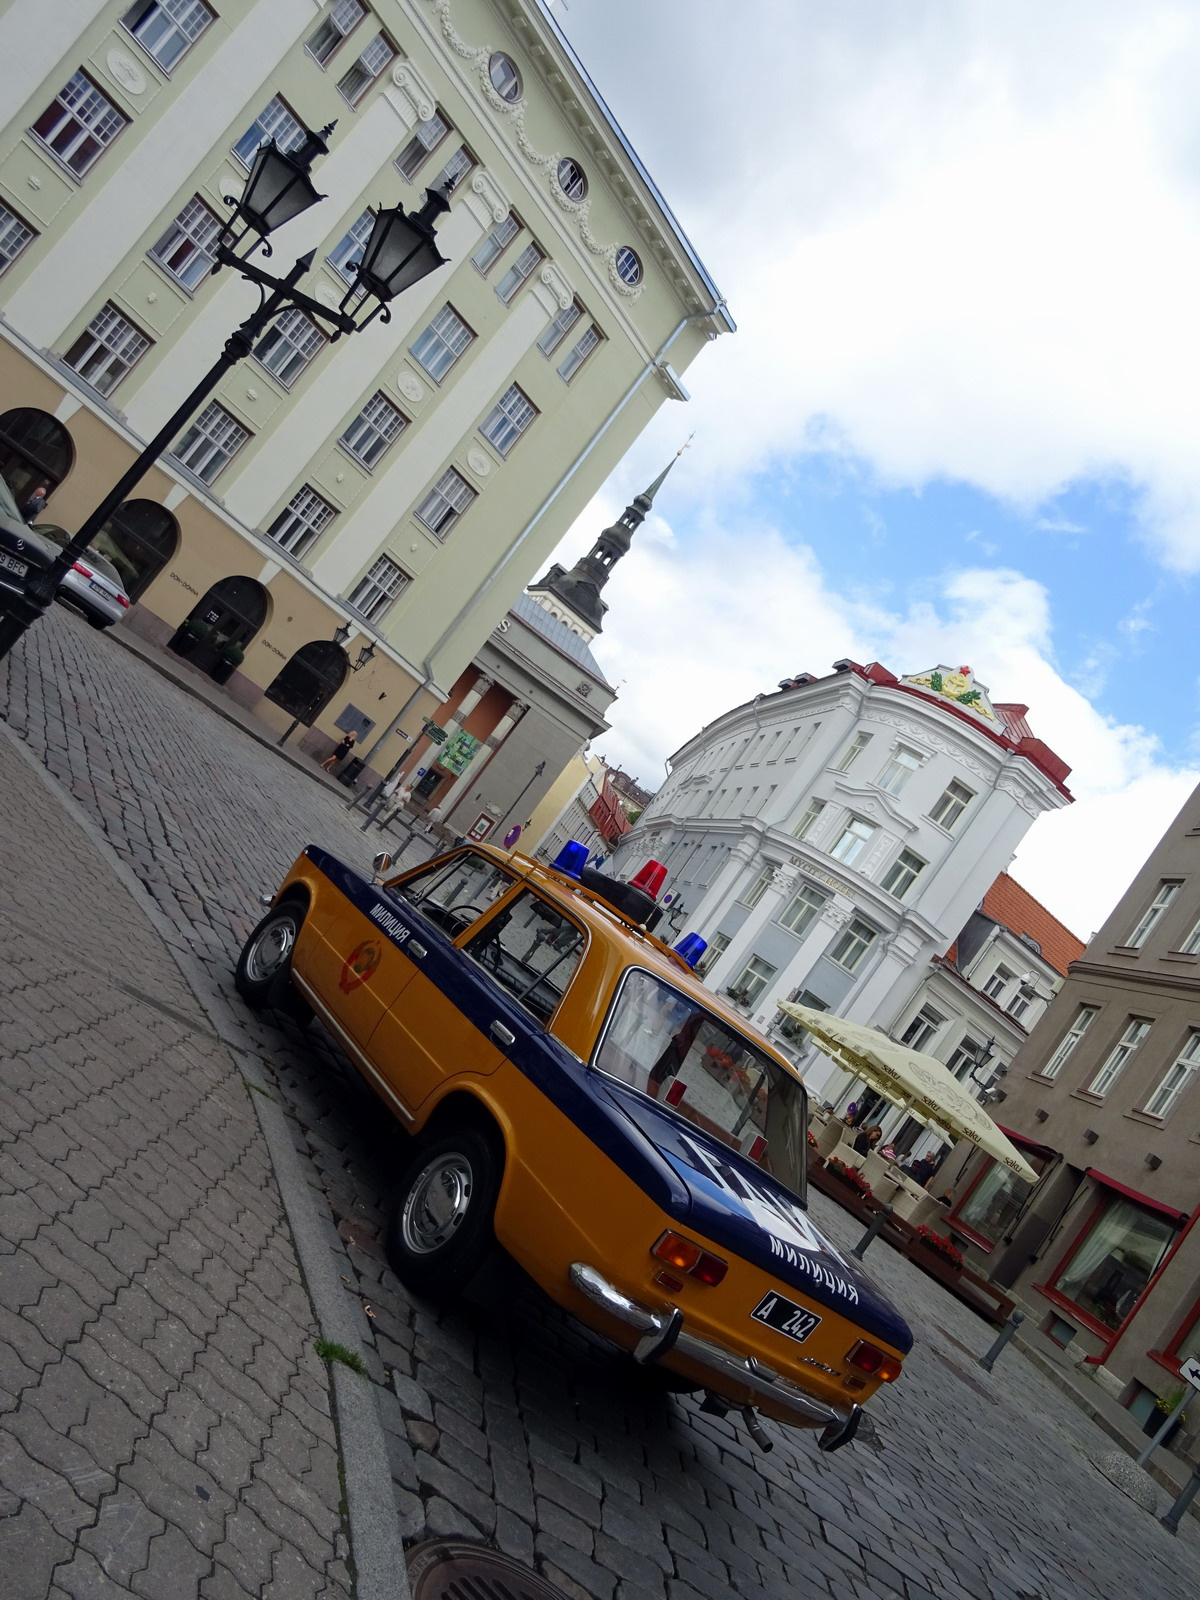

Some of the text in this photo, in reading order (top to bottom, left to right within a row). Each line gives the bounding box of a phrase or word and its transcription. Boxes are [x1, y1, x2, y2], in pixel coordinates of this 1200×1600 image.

[6, 559, 26, 574] BFC
[824, 876, 856, 898] HOTEL
[369, 903, 411, 943] МИЛИЦИЯ
[881, 1064, 901, 1080] saku
[921, 1095, 940, 1112] saku
[962, 1127, 982, 1143] saku
[1003, 1156, 1023, 1173] saku
[768, 1234, 859, 1305] МИЛИЦИЯ
[756, 1297, 815, 1338] A 242
